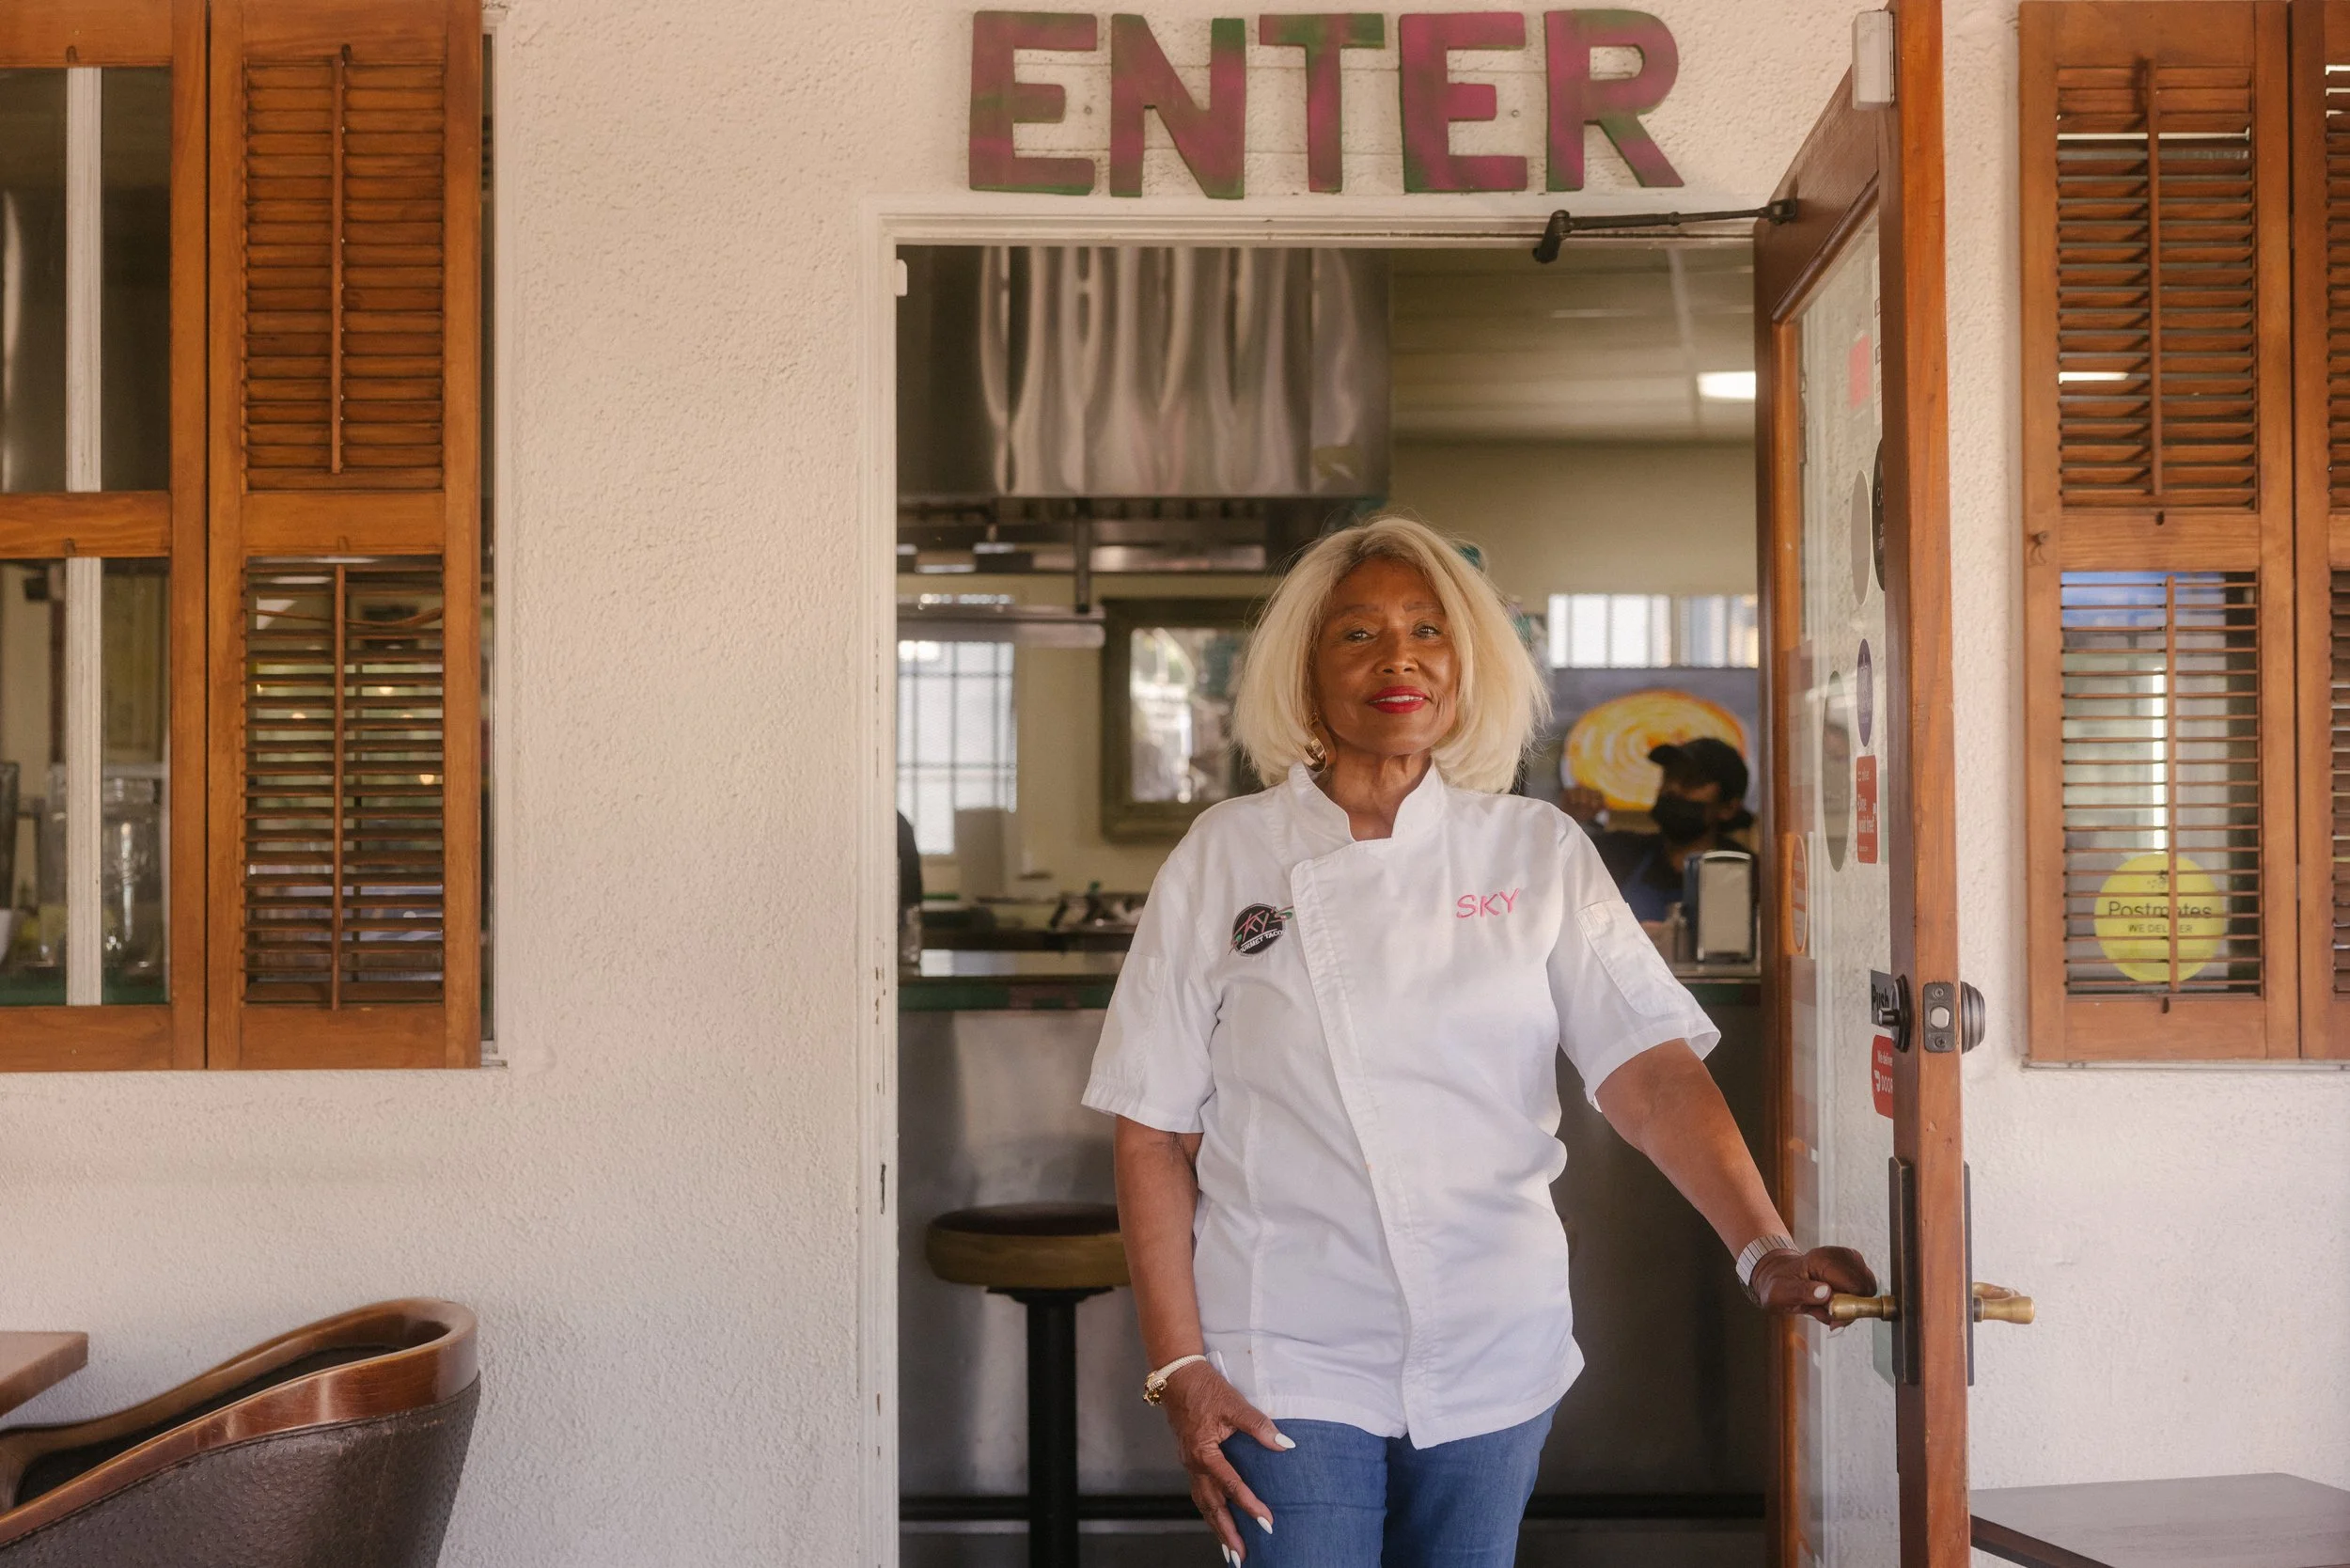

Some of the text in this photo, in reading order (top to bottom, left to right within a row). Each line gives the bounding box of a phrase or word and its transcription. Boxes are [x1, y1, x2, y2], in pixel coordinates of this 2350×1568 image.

[969, 9, 1684, 200] ENTER
[1456, 887, 1519, 919] SKY
[2128, 924, 2193, 933] WE DELER
[1872, 984, 1889, 1011] Push
